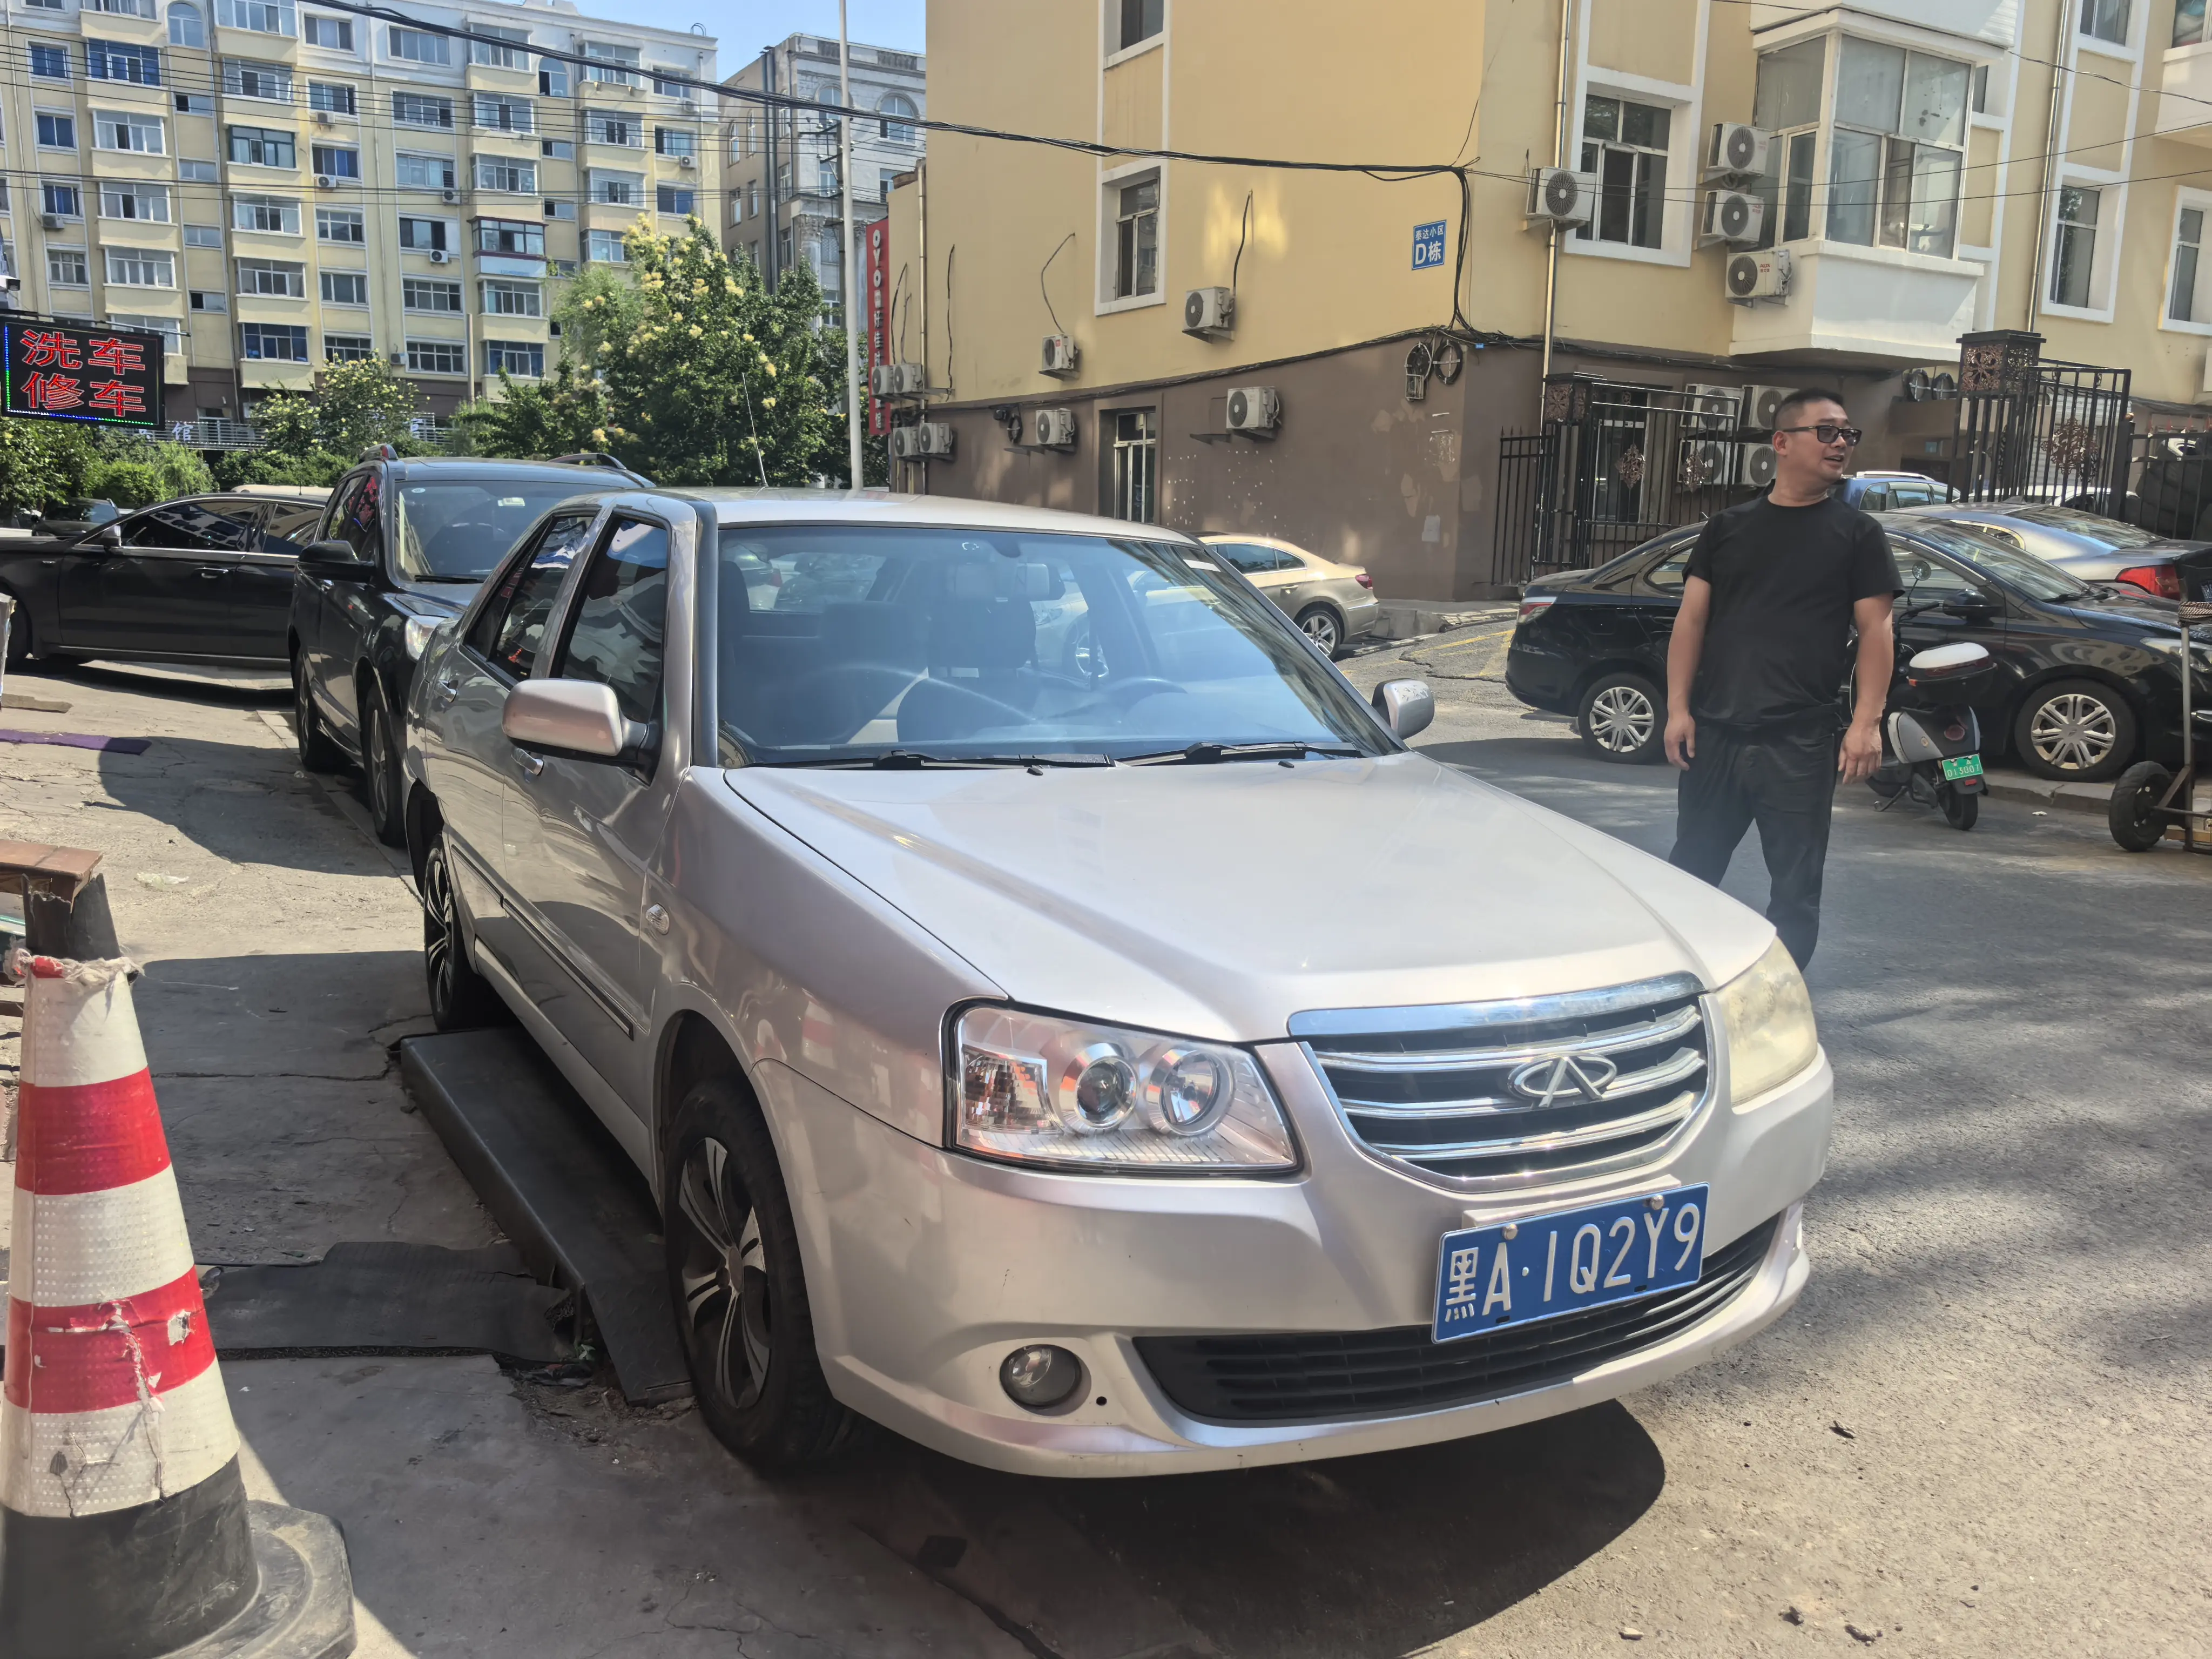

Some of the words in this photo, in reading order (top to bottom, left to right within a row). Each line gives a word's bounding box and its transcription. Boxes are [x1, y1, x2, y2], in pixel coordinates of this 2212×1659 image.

[873, 229, 881, 288] OYO
[1415, 240, 1442, 265] D栋
[20, 329, 145, 375] 洗车
[21, 371, 146, 417] 修车
[1947, 764, 1979, 777] 013007
